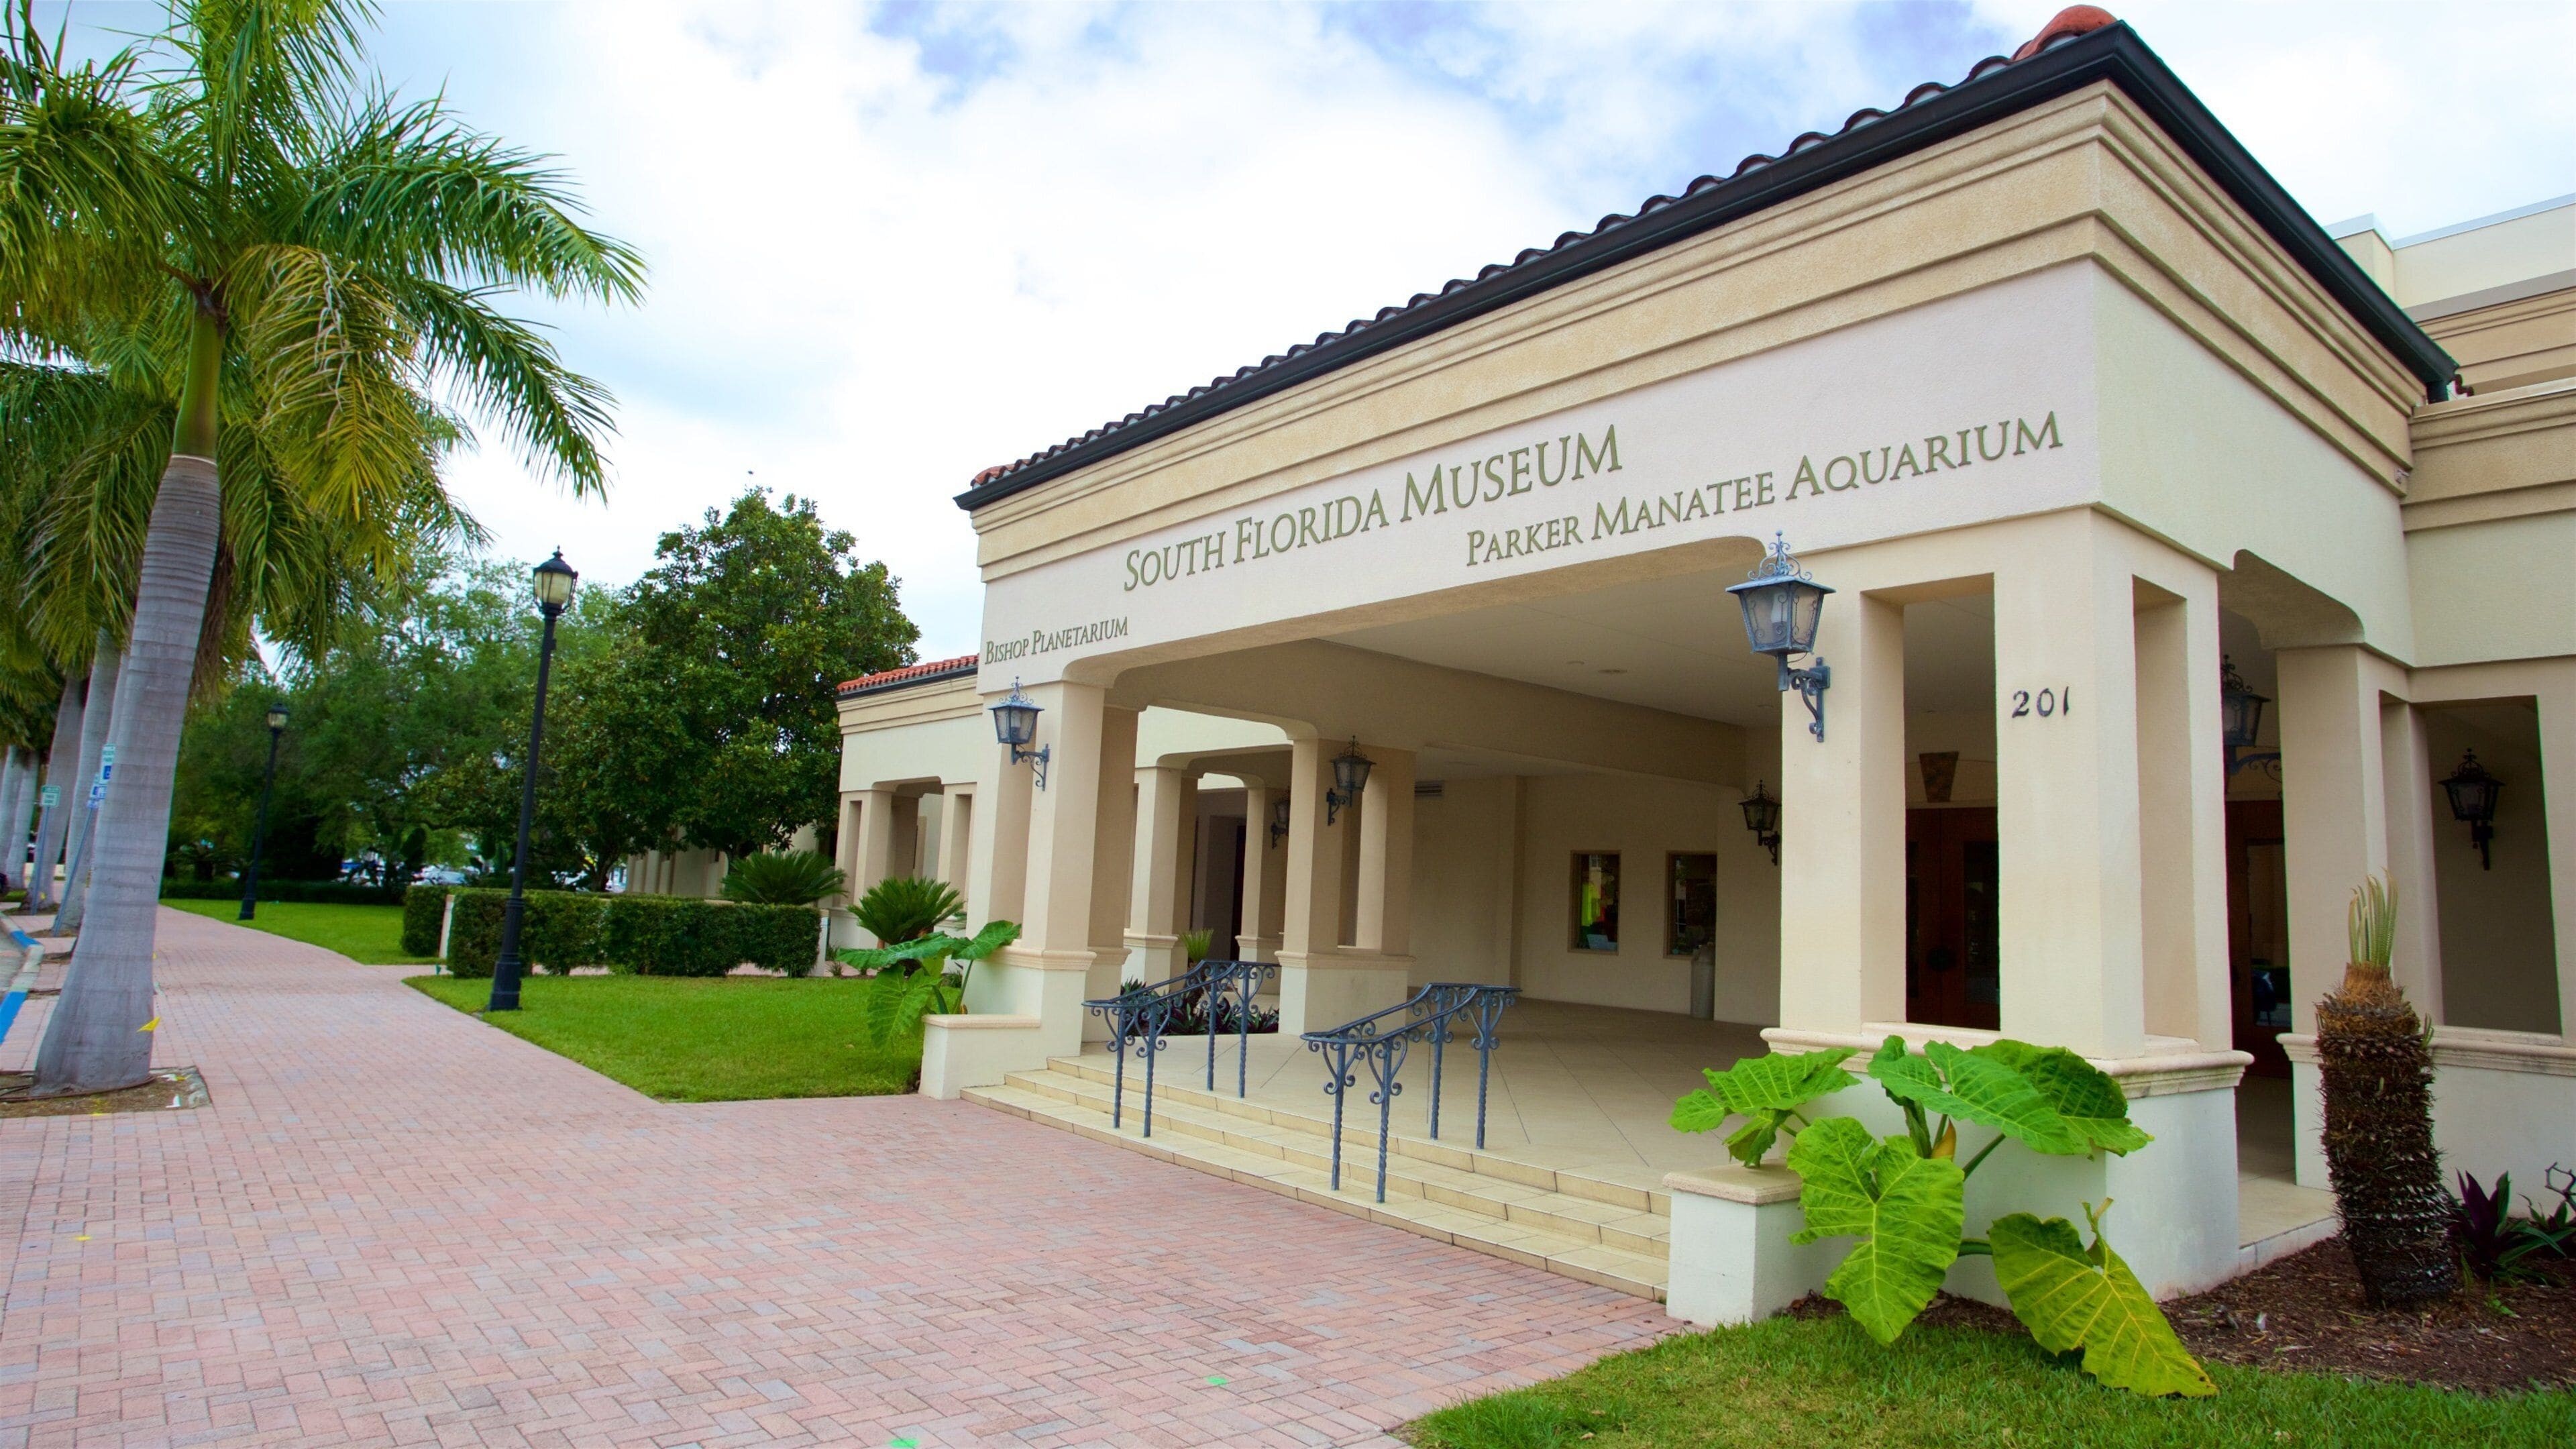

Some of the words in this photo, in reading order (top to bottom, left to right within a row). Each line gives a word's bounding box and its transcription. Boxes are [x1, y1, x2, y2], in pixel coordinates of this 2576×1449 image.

[1123, 531, 1226, 592] SOUTH
[1233, 488, 1390, 565] FLORIDA
[1399, 423, 1623, 523] MUSEUM
[1466, 515, 1584, 567] PARKER
[1591, 471, 1776, 541] MANATEE
[1784, 411, 2064, 501] AQUARIUM
[984, 638, 1030, 665] BISHOP
[1031, 616, 1128, 655] PLANETARIUM
[2011, 685, 2070, 718] 201
